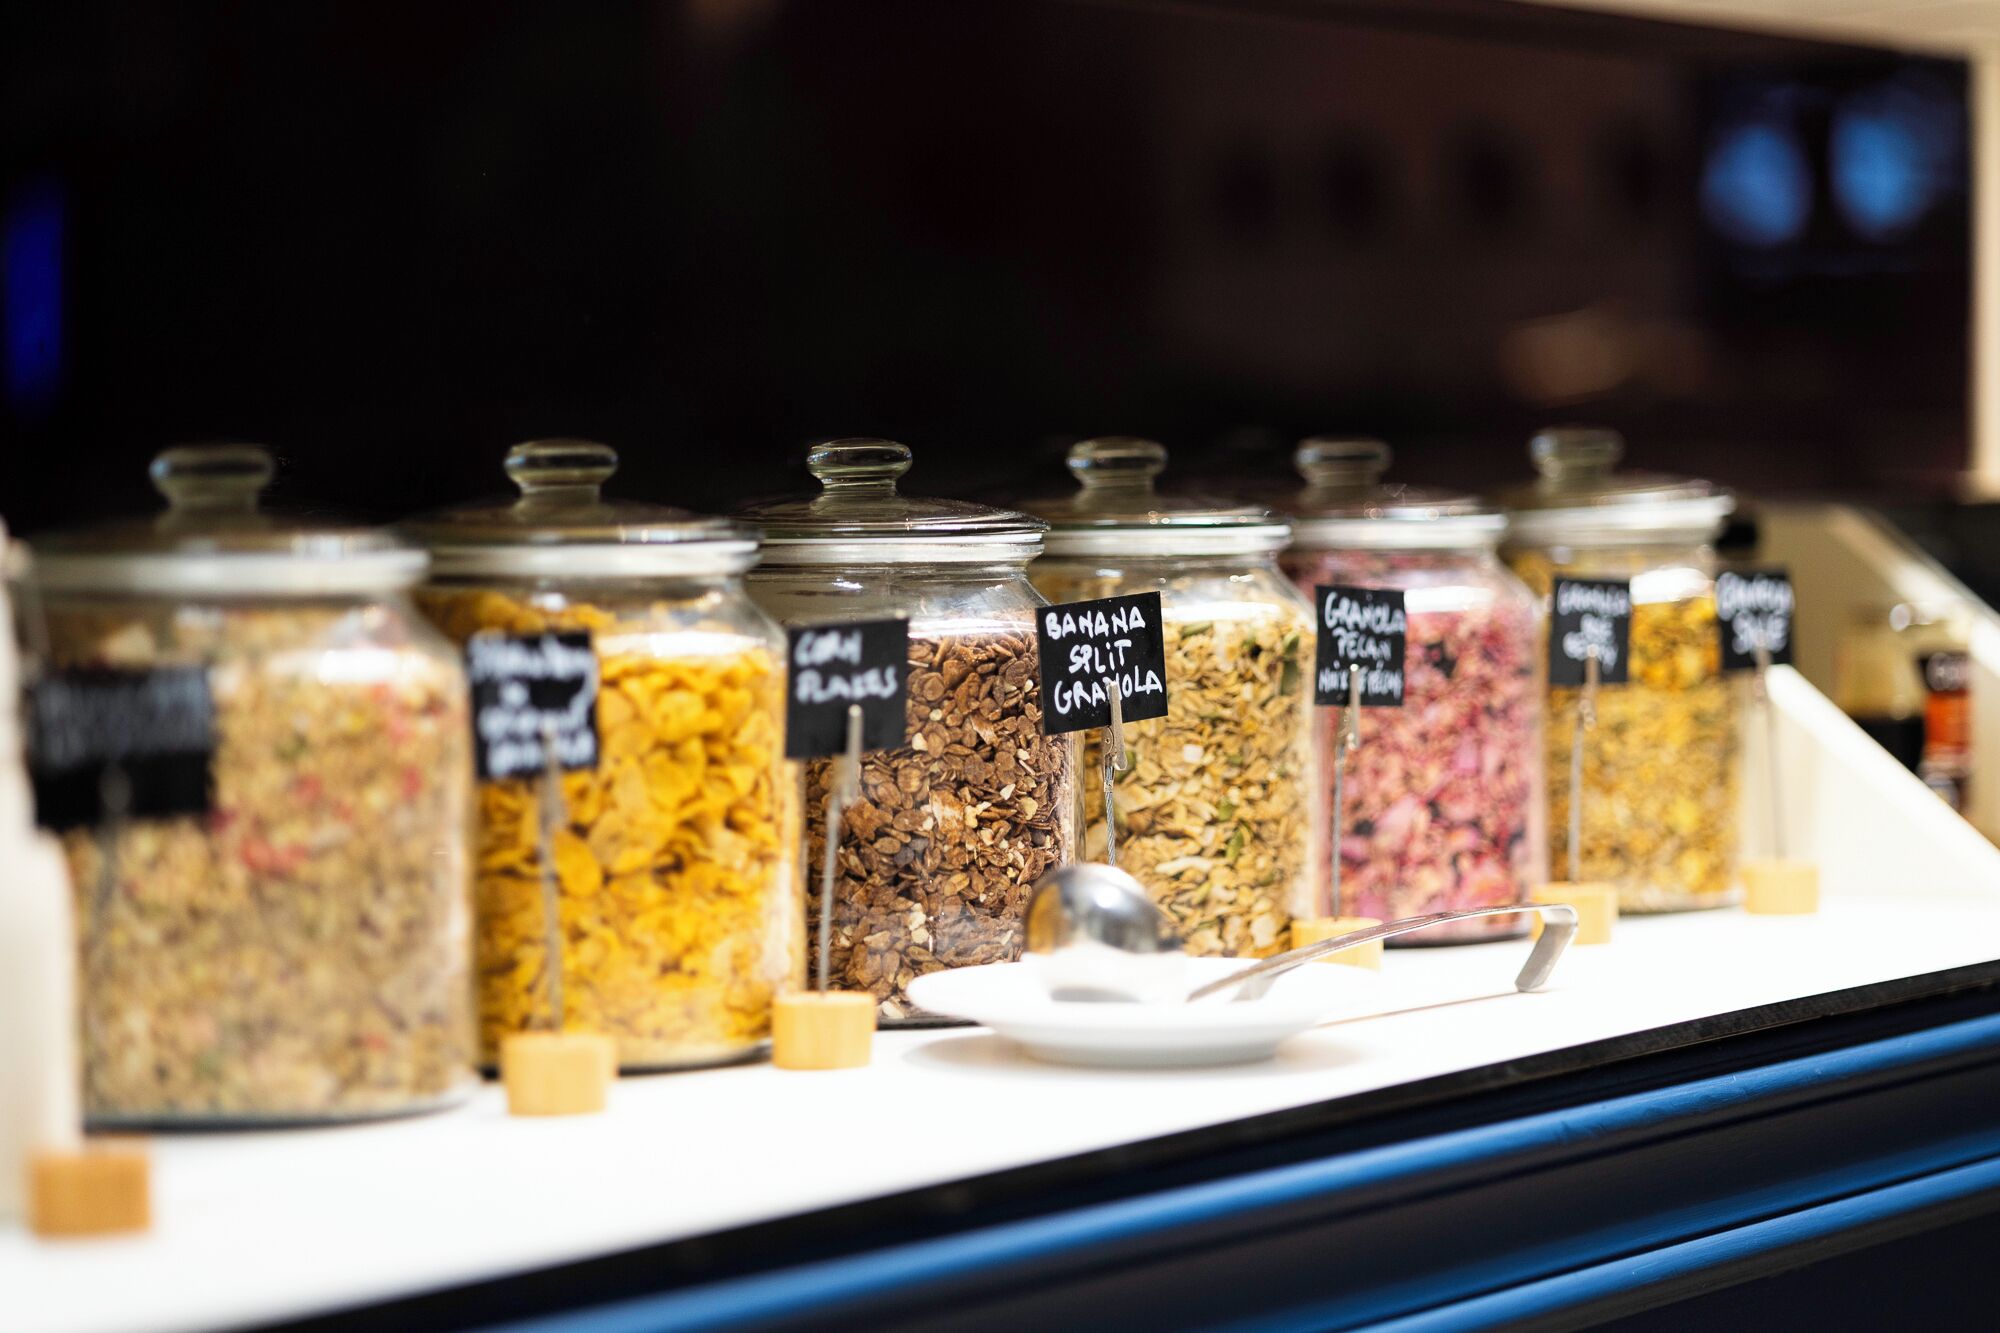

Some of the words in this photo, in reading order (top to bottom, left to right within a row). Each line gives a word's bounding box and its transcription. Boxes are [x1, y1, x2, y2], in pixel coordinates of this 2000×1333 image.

[1045, 606, 1146, 640] BANANA
[1325, 591, 1407, 635] GRANOLA
[1068, 639, 1132, 674] SPLiT
[796, 665, 898, 704] FLAKES
[1054, 665, 1163, 714] GRANOLA
